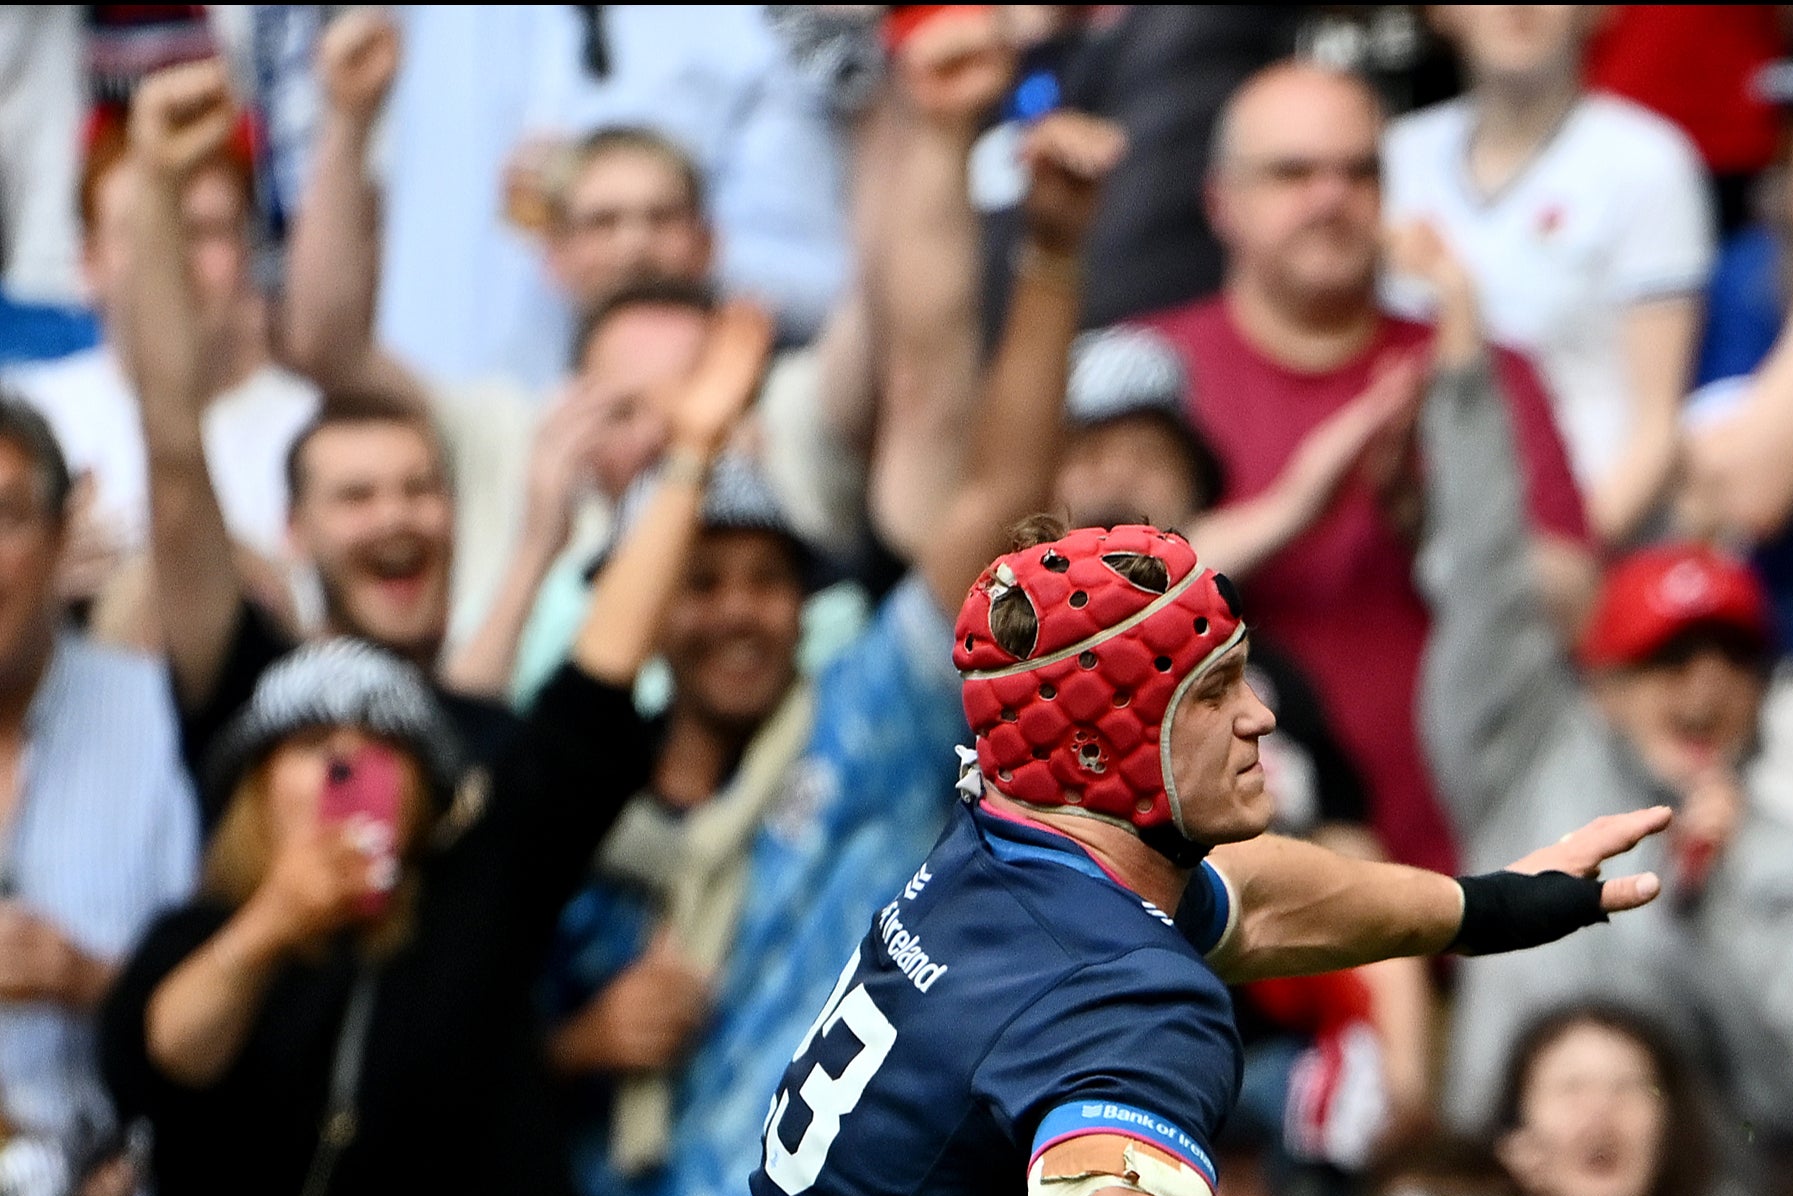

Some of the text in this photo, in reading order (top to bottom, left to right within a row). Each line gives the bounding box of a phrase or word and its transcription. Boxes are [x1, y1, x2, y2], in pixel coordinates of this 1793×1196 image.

[882, 908, 948, 994] Ireland
[1103, 1104, 1155, 1130] Bank
[1155, 1122, 1178, 1139] of
